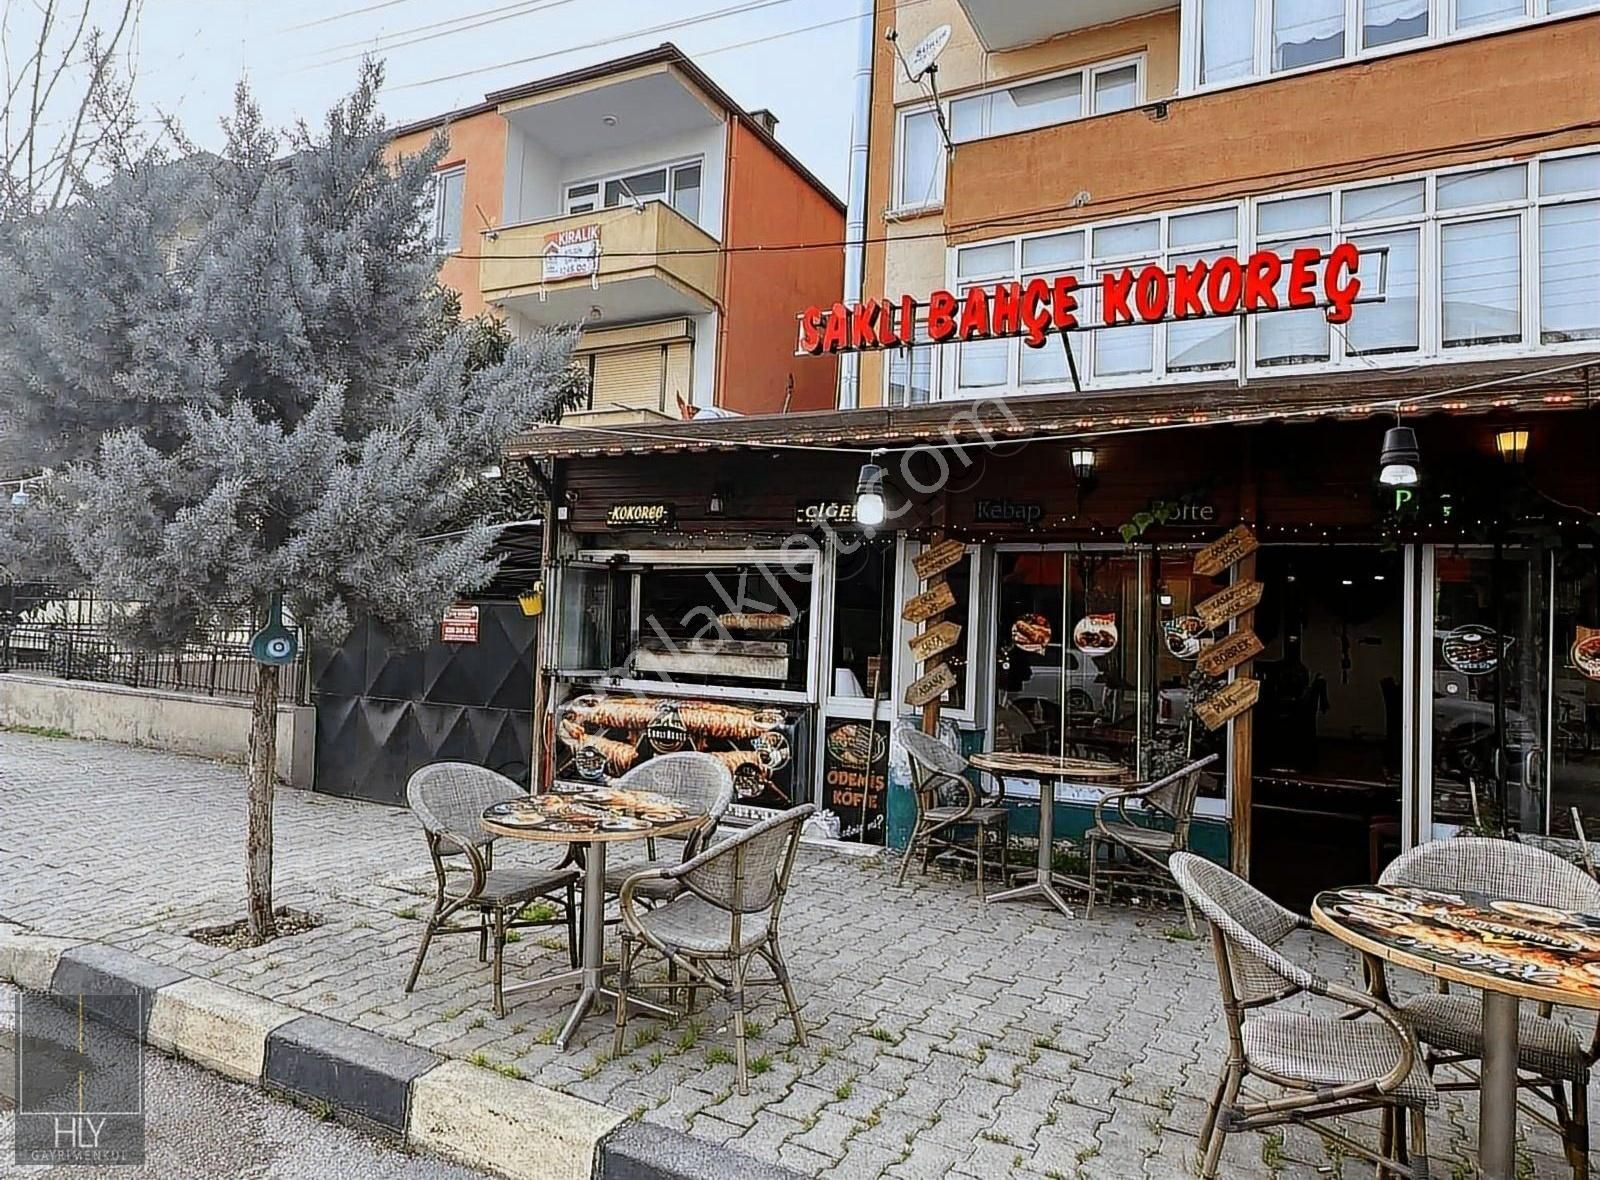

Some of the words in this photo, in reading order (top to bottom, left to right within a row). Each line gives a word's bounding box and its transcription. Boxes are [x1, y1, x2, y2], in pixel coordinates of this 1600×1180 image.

[559, 225, 599, 246] KIRALIK
[800, 294, 915, 355] SAKLI
[928, 276, 1079, 348] BAHÇE
[1102, 243, 1361, 326] KOKOREÇ
[977, 500, 1040, 522] Kebap
